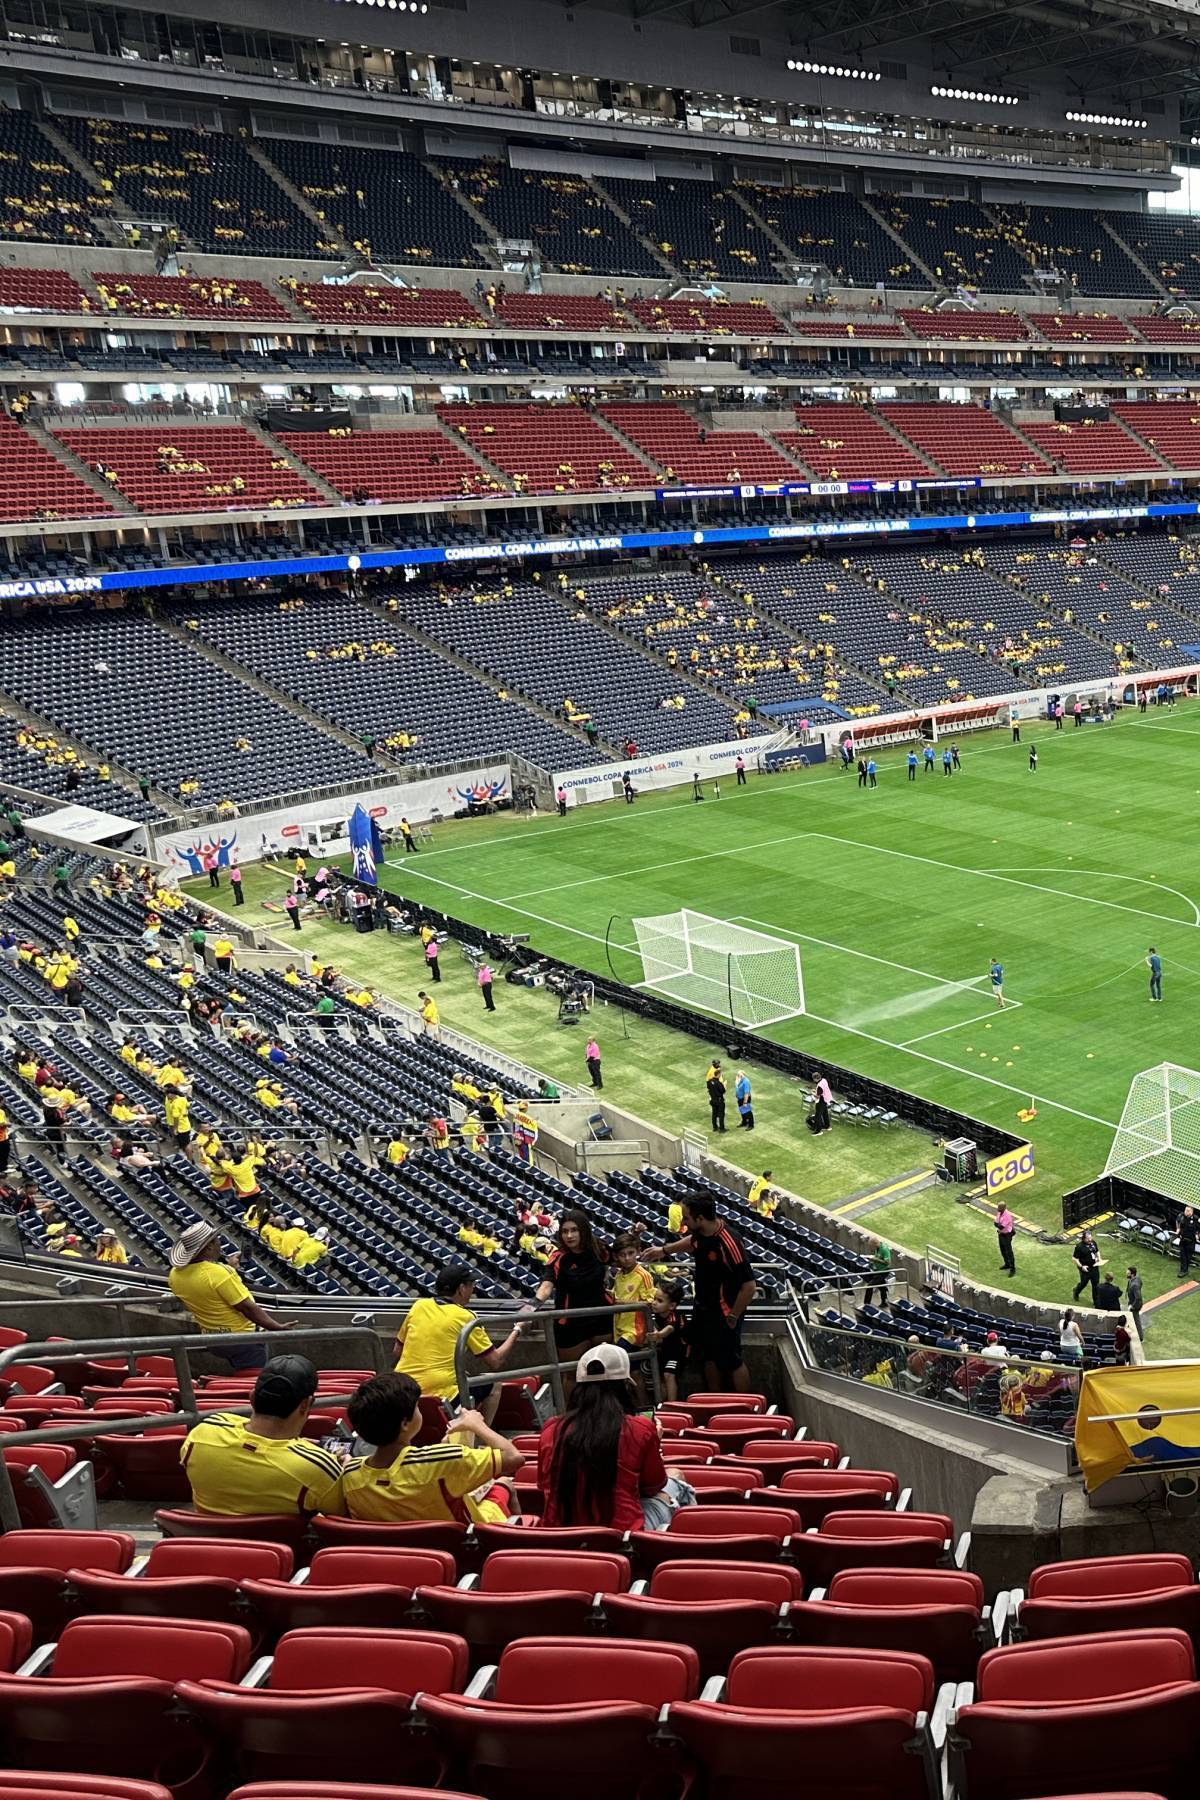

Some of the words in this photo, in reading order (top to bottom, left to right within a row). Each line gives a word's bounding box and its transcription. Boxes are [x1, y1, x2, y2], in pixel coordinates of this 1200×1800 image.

[445, 547, 505, 560] CONMEBOL
[505, 543, 533, 556] COPA
[534, 539, 579, 554] AMERICA
[36, 579, 66, 594] USA
[66, 577, 102, 592] 2024
[709, 749, 744, 760] CONMEBOL
[562, 776, 602, 789] CONMEBOL
[603, 771, 622, 781] COPA
[668, 761, 683, 769] 2024
